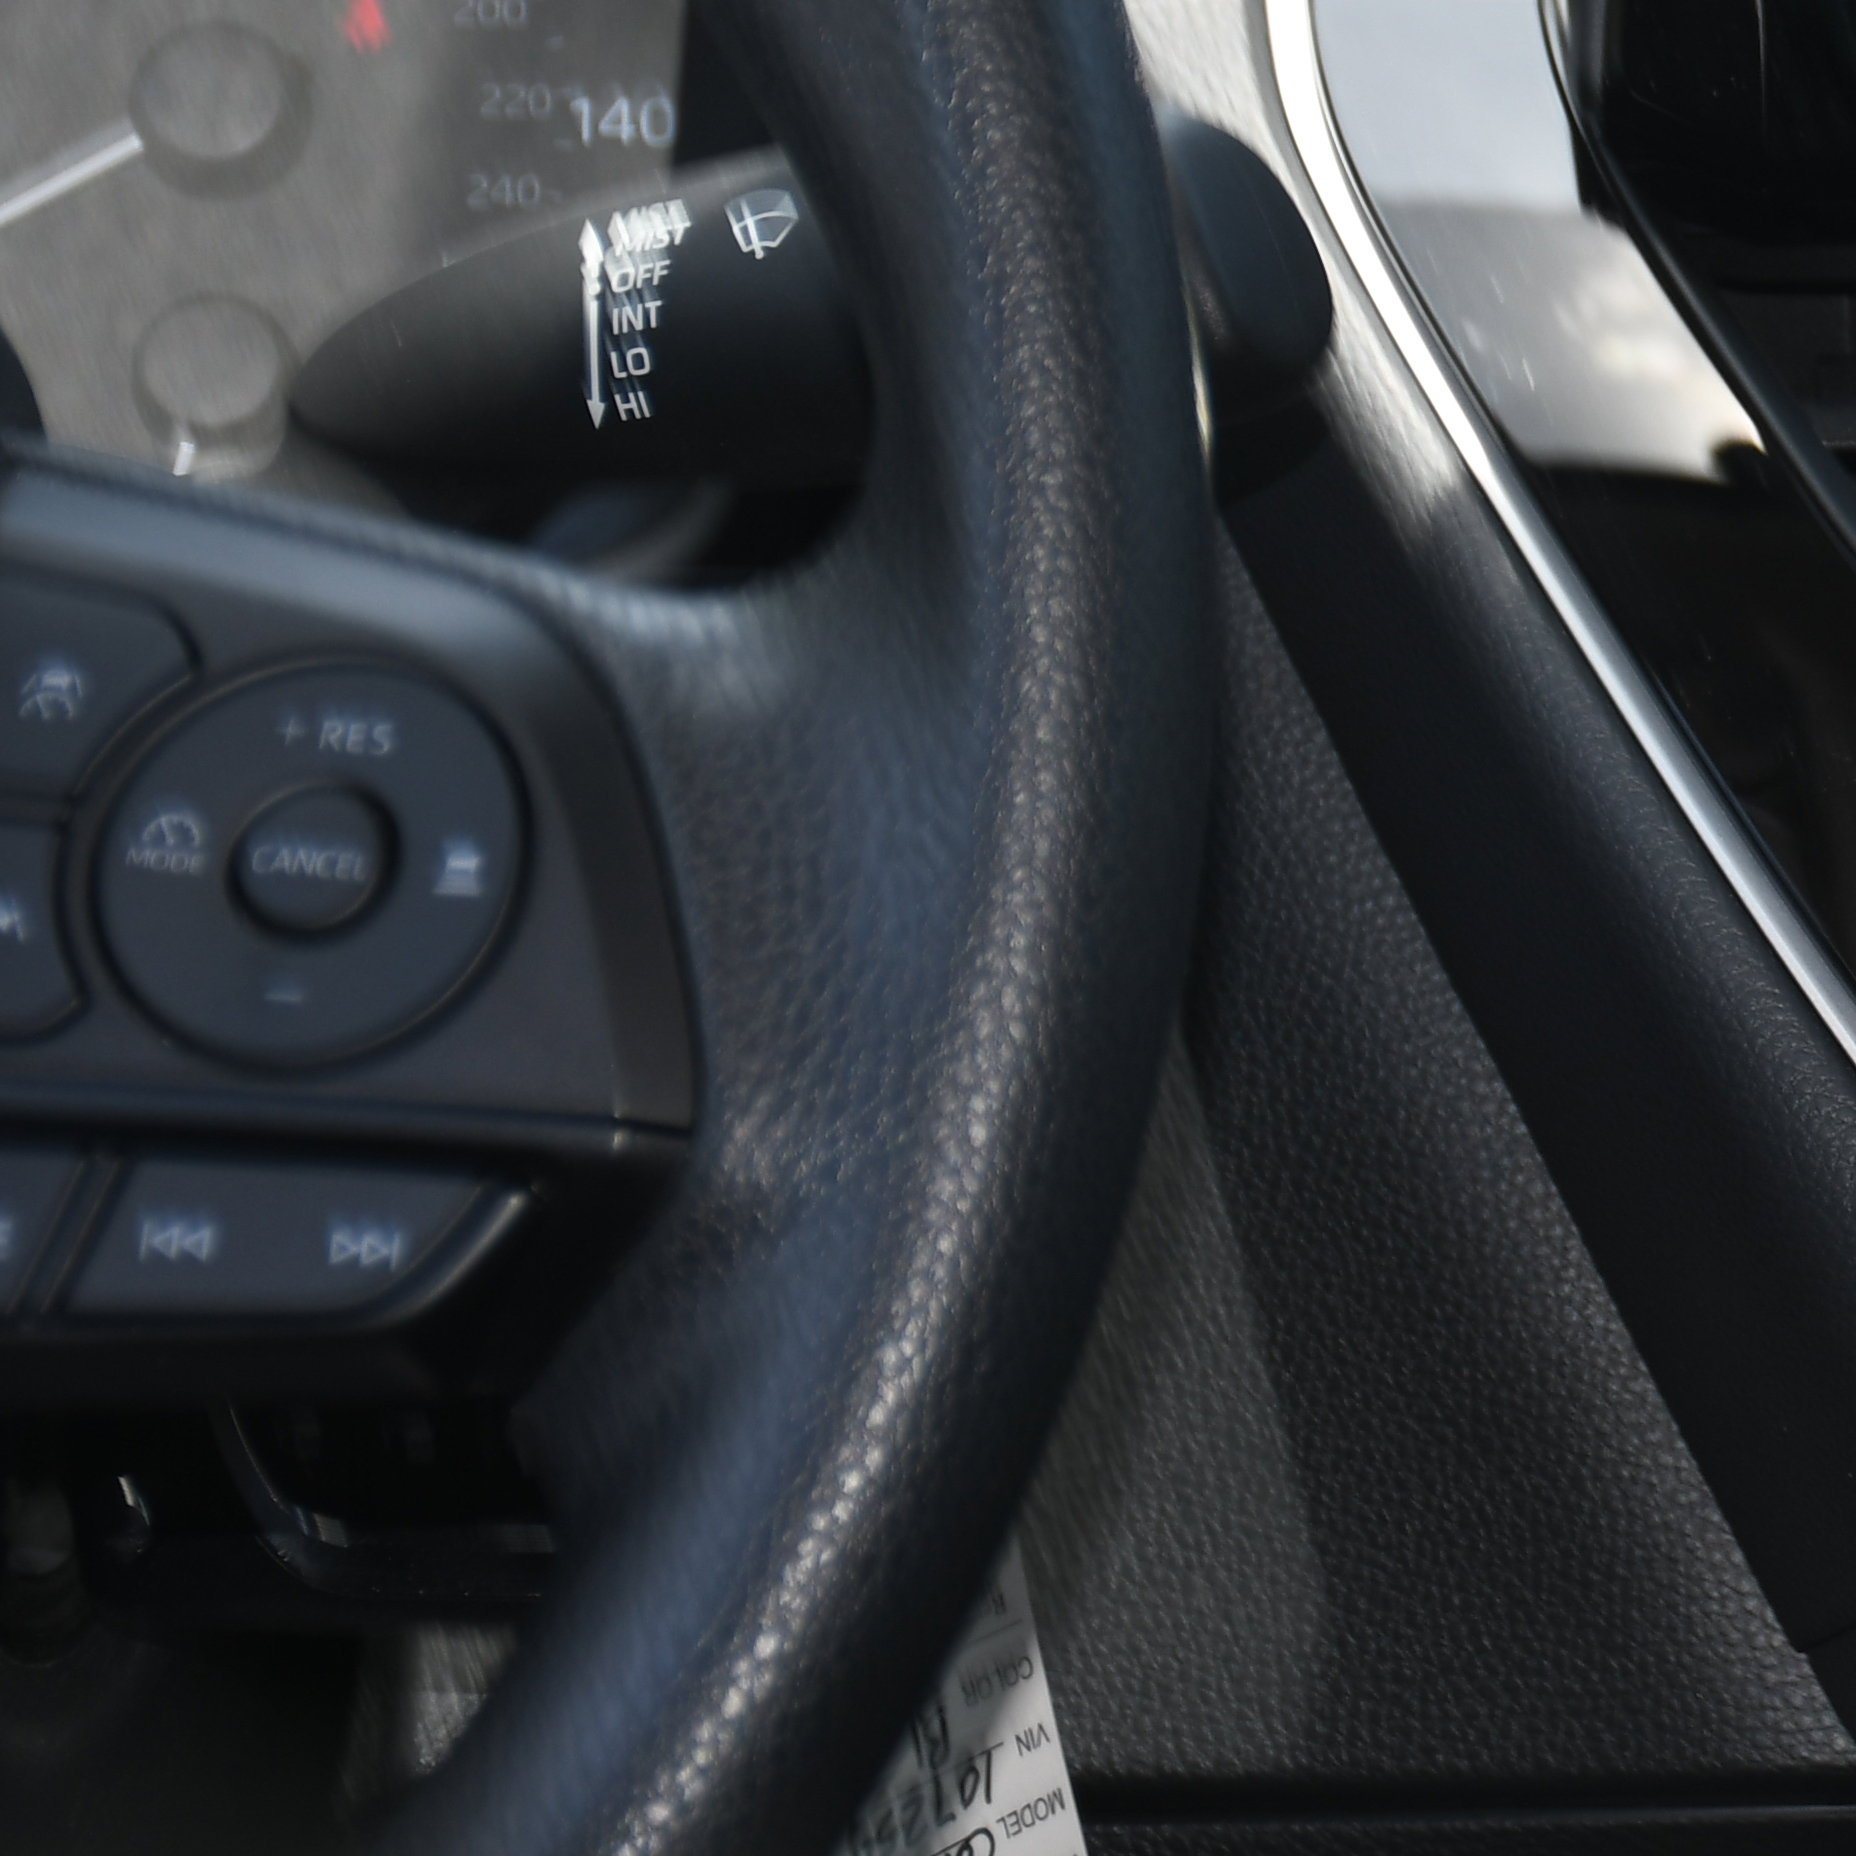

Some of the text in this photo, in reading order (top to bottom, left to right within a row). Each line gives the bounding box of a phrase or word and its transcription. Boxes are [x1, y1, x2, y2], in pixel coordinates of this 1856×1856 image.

[479, 81, 551, 118] 220
[569, 94, 676, 146] 140
[467, 173, 541, 209] 240
[611, 260, 670, 293] OFF
[612, 300, 662, 335] INT
[610, 347, 651, 379] LO
[614, 391, 651, 421] HI
[318, 720, 393, 756] RES
[126, 847, 209, 876] MODE
[251, 845, 367, 882] CANCEL
[960, 1656, 1034, 1707] COLOR
[1015, 1723, 1051, 1757] VIN
[997, 1788, 1066, 1839] MODEL
